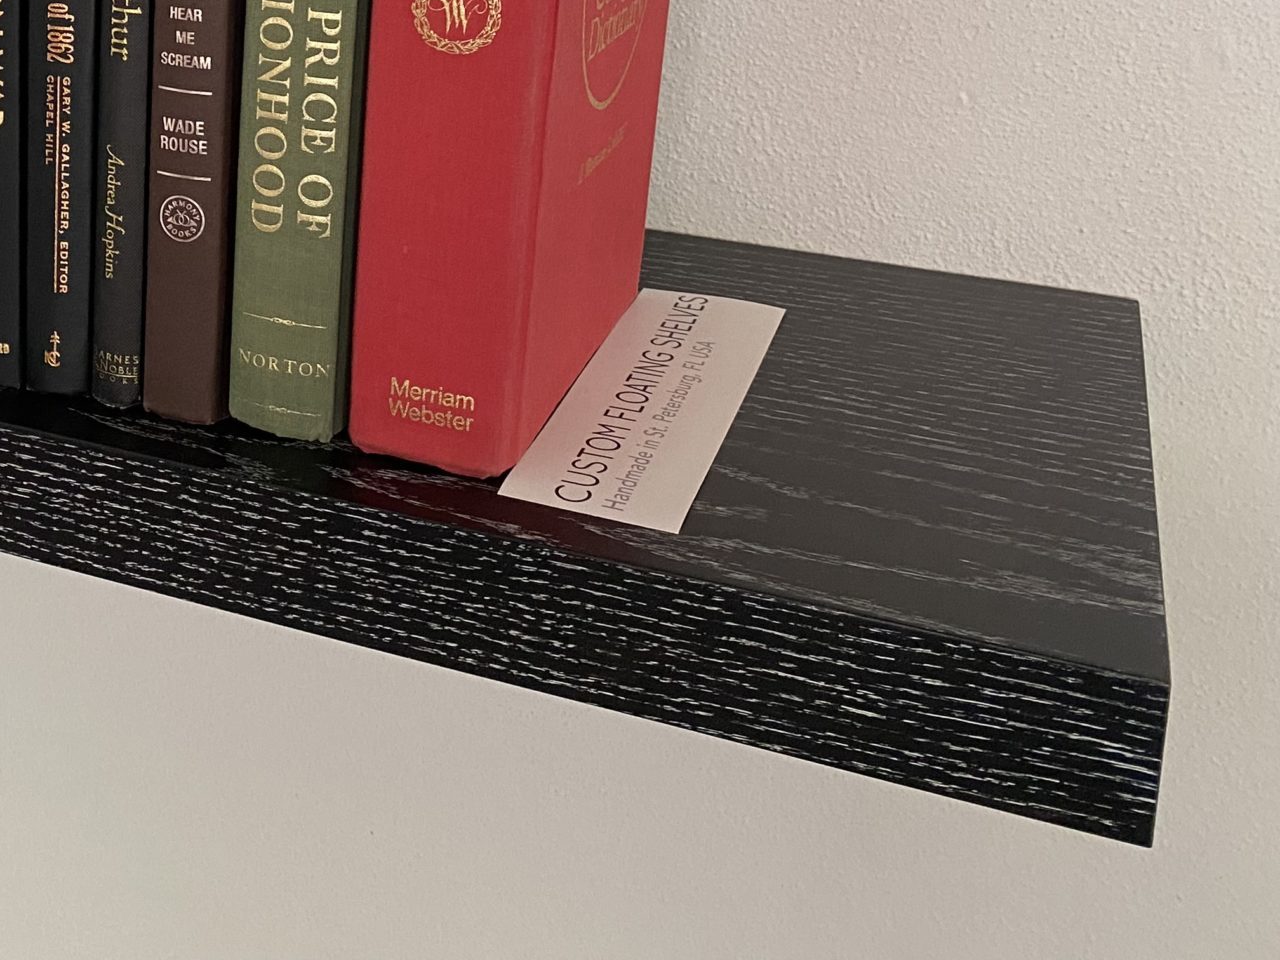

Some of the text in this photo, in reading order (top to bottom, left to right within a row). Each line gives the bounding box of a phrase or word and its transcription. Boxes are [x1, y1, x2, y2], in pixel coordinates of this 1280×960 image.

[47, 3, 75, 24] of
[170, 6, 203, 23] HEAR
[46, 23, 75, 64] 1862
[176, 31, 195, 46] ME
[161, 51, 212, 70] SCREAM
[300, 7, 343, 154] PRICE
[45, 74, 55, 165] CHAPEL HILL
[163, 116, 205, 136] WADE
[160, 135, 208, 155] ROUSE
[59, 76, 71, 294] GARY W. GALLAGHER, EDITOR
[102, 144, 125, 280] Andrea Hopkins
[164, 199, 200, 221] HARMONY
[296, 174, 334, 239] OF
[166, 224, 197, 238] BOOKS
[94, 347, 139, 364] ARNES
[238, 348, 331, 377] NORTON
[390, 376, 475, 412] Merriam
[554, 295, 709, 503] CUSTOM FLOATING SHELVES
[388, 397, 474, 432] Webster
[602, 341, 716, 512] Handmade in St. Petersburg, FL USA
